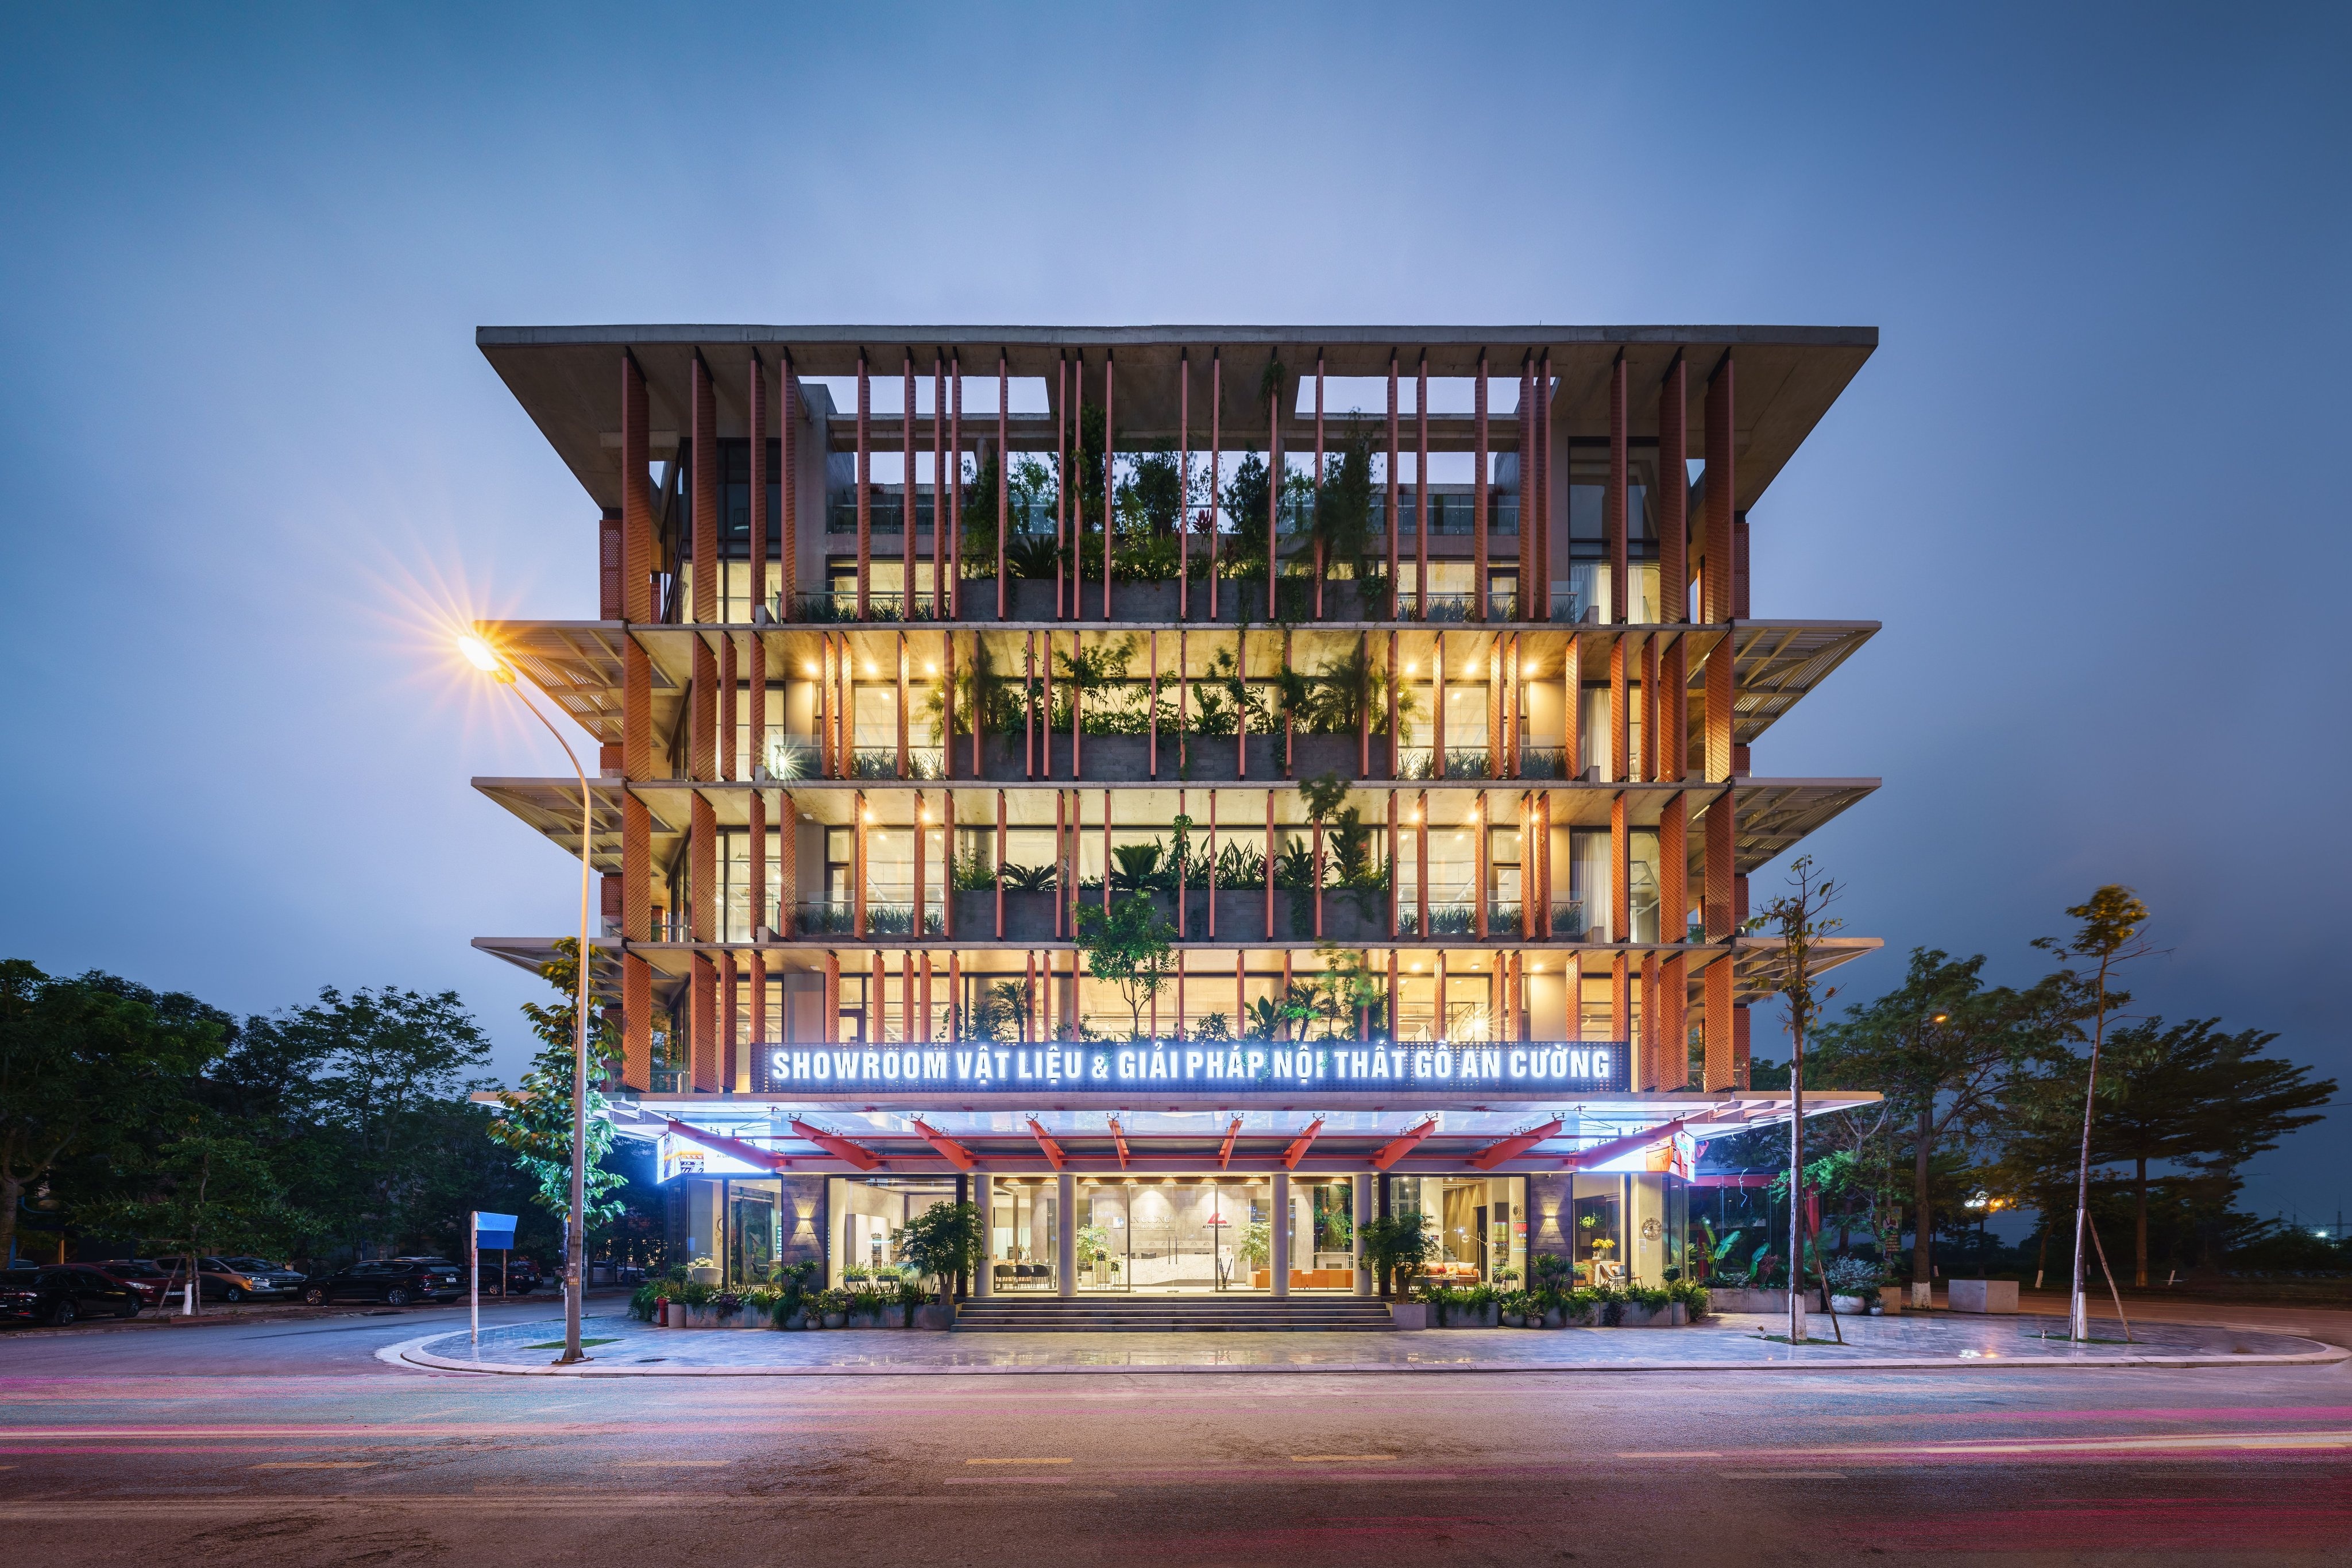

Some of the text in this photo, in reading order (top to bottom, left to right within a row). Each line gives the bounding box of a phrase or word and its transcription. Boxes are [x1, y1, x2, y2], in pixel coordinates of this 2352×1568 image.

[773, 1040, 1609, 1084] SHOWROOM VẬT LIỆU & GIẢI PHÁP NỘI THẤT GỖ AN CƯỜNG
